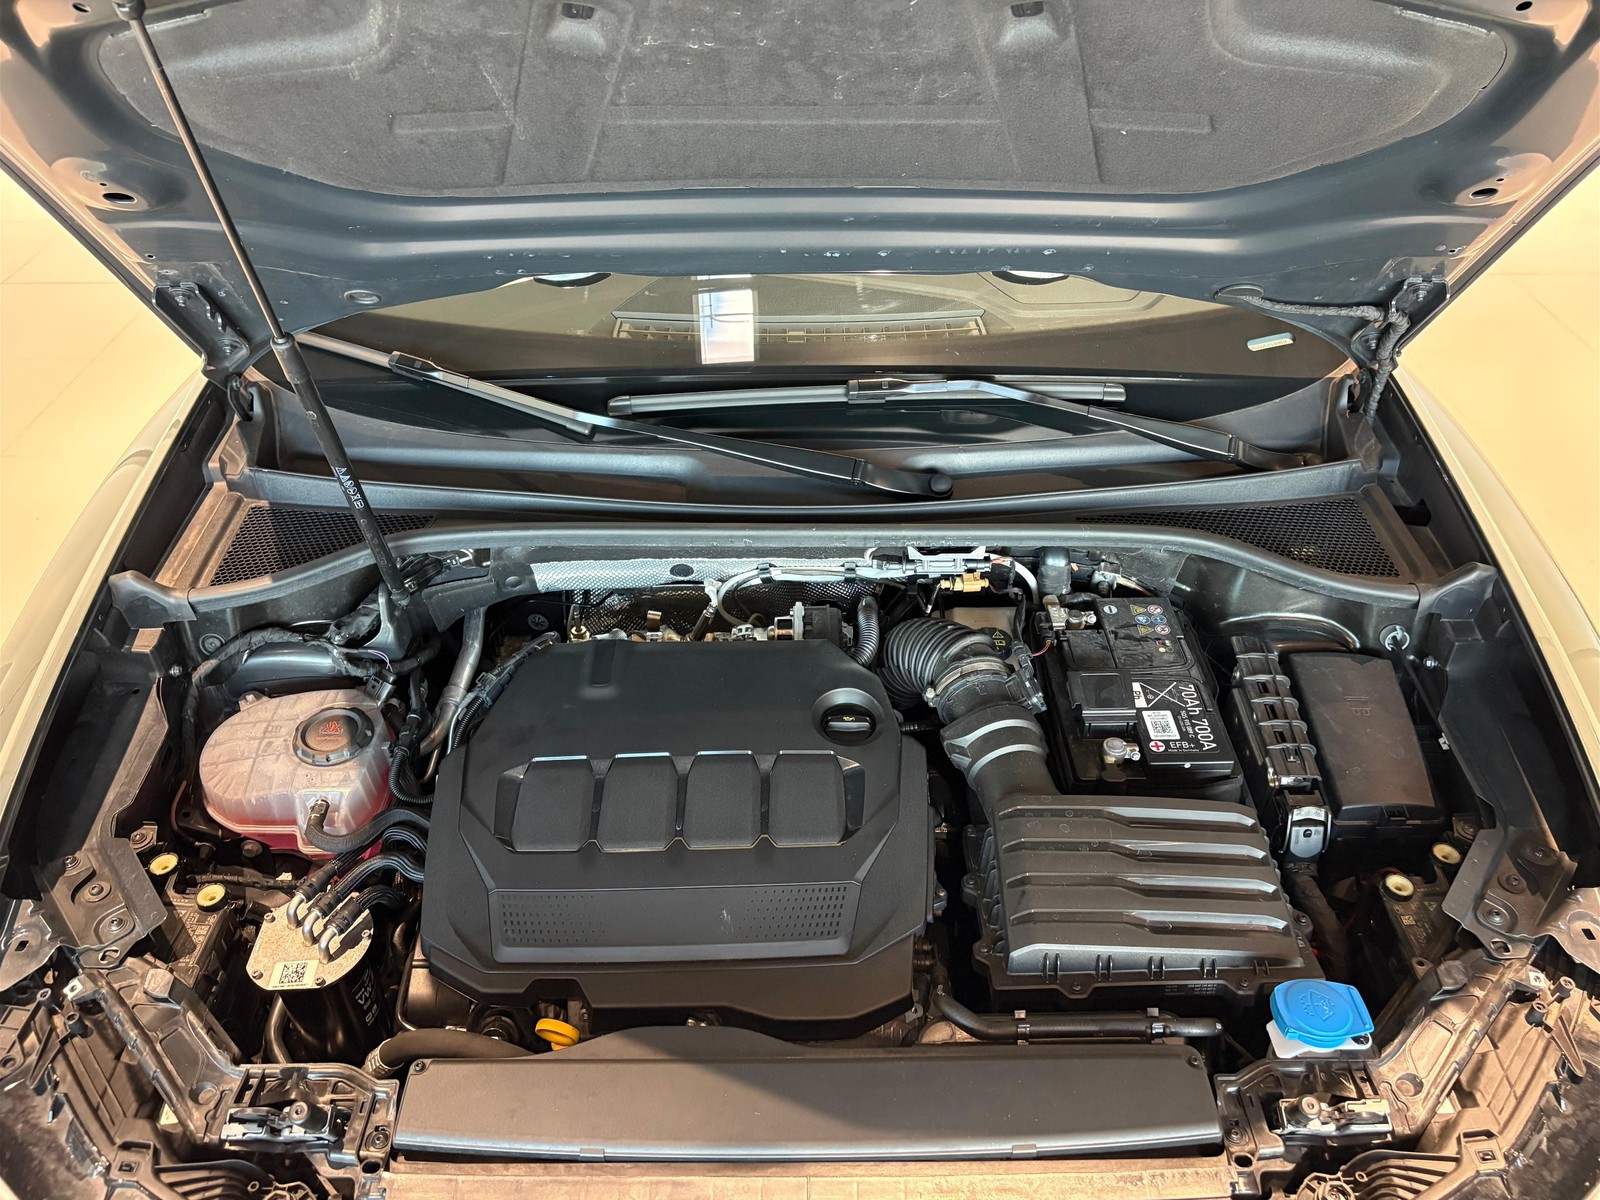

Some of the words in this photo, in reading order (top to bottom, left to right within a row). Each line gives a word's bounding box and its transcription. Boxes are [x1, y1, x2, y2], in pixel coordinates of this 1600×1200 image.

[1179, 684, 1203, 715] 70Ah
[1192, 718, 1217, 751] 700A
[1169, 741, 1195, 749] EFB+
